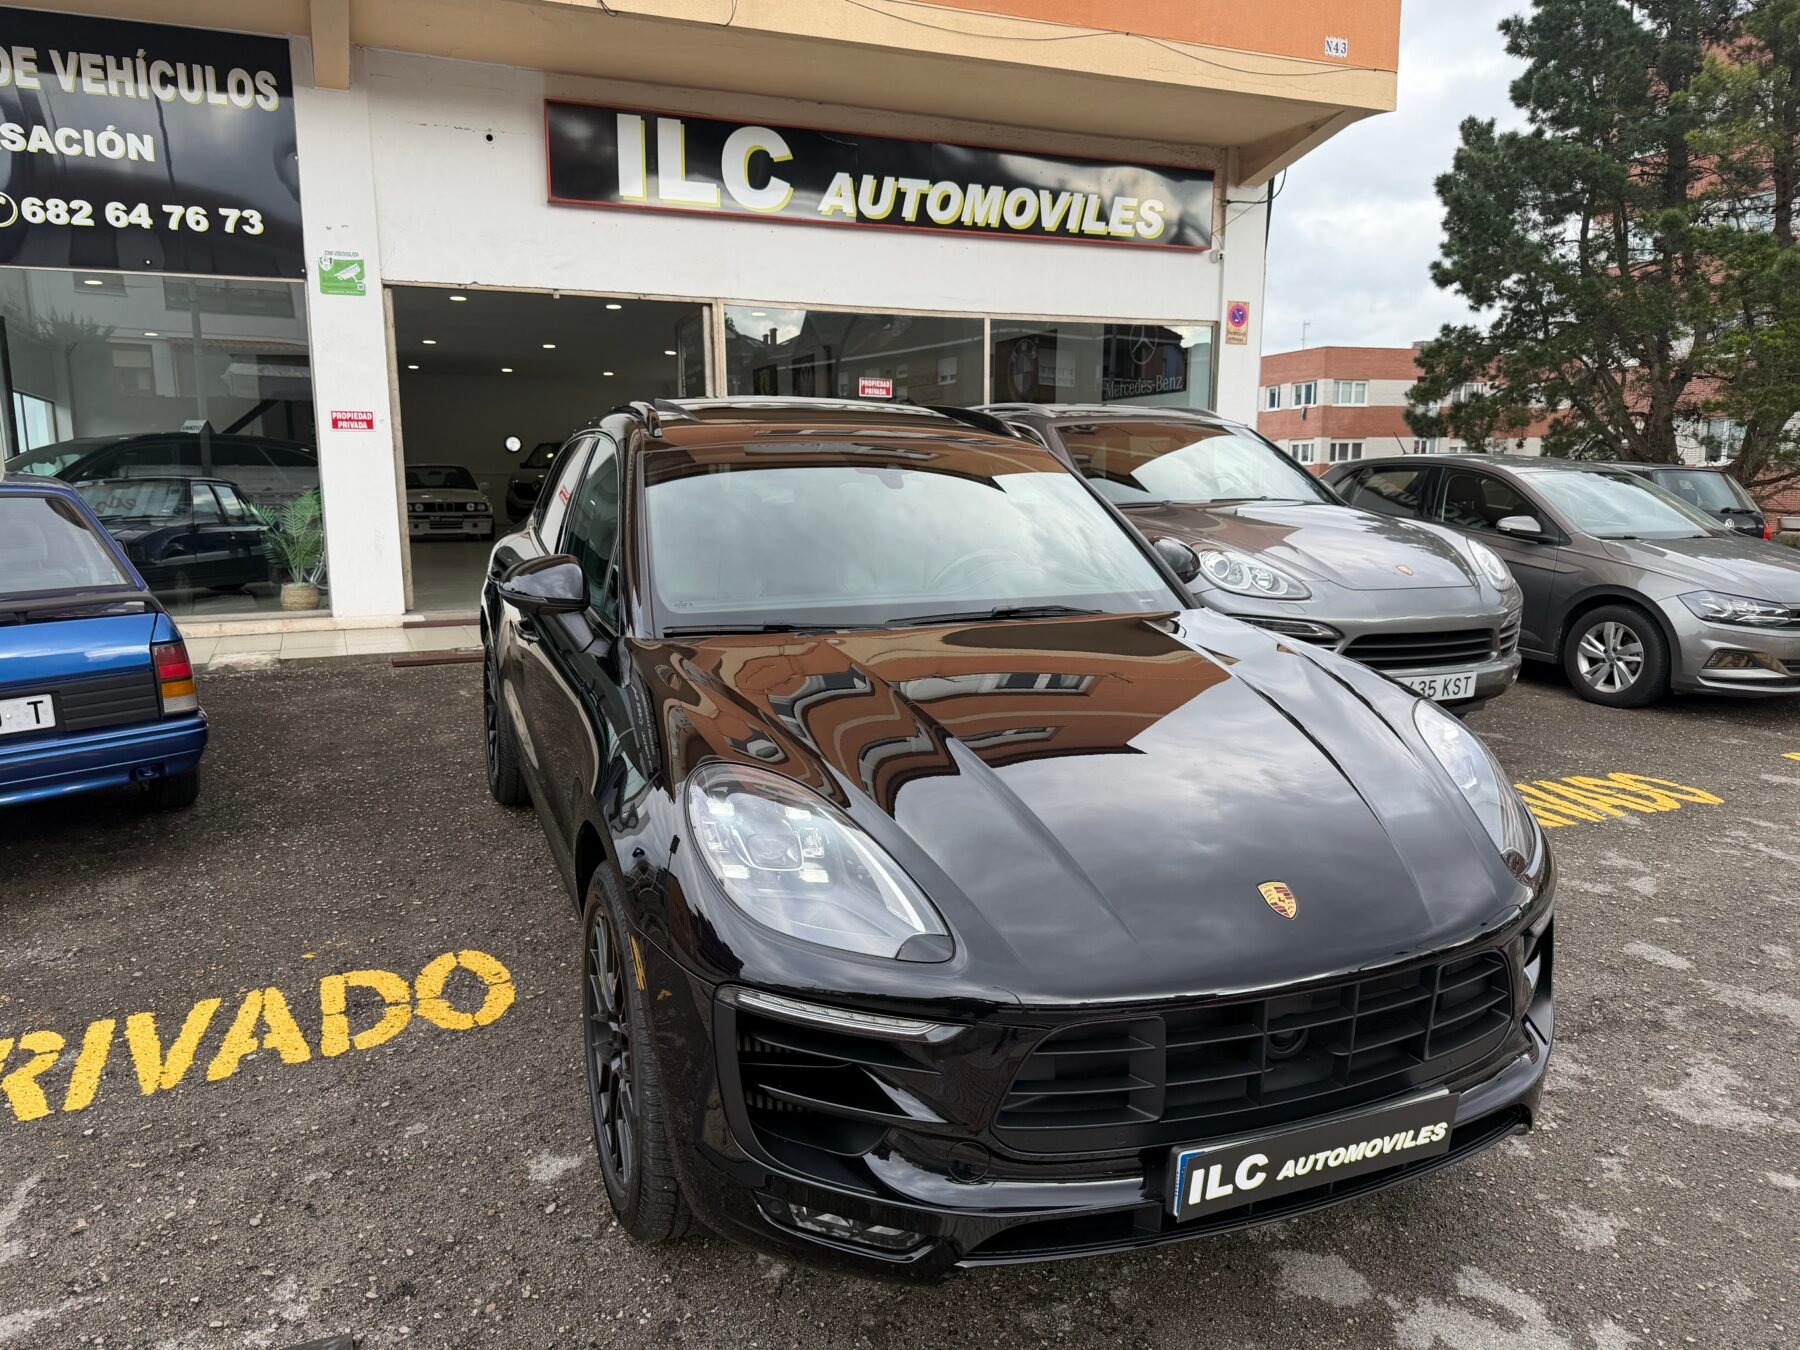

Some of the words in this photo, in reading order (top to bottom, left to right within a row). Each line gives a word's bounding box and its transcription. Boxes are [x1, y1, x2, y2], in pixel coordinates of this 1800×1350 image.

[49, 49, 280, 112] VEHÍCULOS
[0, 124, 156, 163] SACIÓN
[616, 113, 794, 214] ILC
[818, 171, 1165, 240] AUTOMOVILES
[21, 196, 95, 227] 682
[105, 201, 154, 230] 64
[162, 204, 210, 233] 76
[218, 207, 265, 235] 73
[861, 380, 890, 388] PROPIEDAD
[865, 387, 887, 395] PRIVADA
[1105, 374, 1184, 399] Mercedes-Benz
[331, 411, 373, 420] PROPIEDAD
[337, 420, 368, 429] PRIVADA
[1408, 680, 1438, 698] 35
[1441, 676, 1472, 697] KST
[26, 700, 44, 725] T
[1514, 772, 1726, 829] VADO
[1188, 1153, 1270, 1206] ILC
[1276, 1121, 1449, 1181] AUTOMOVILES
